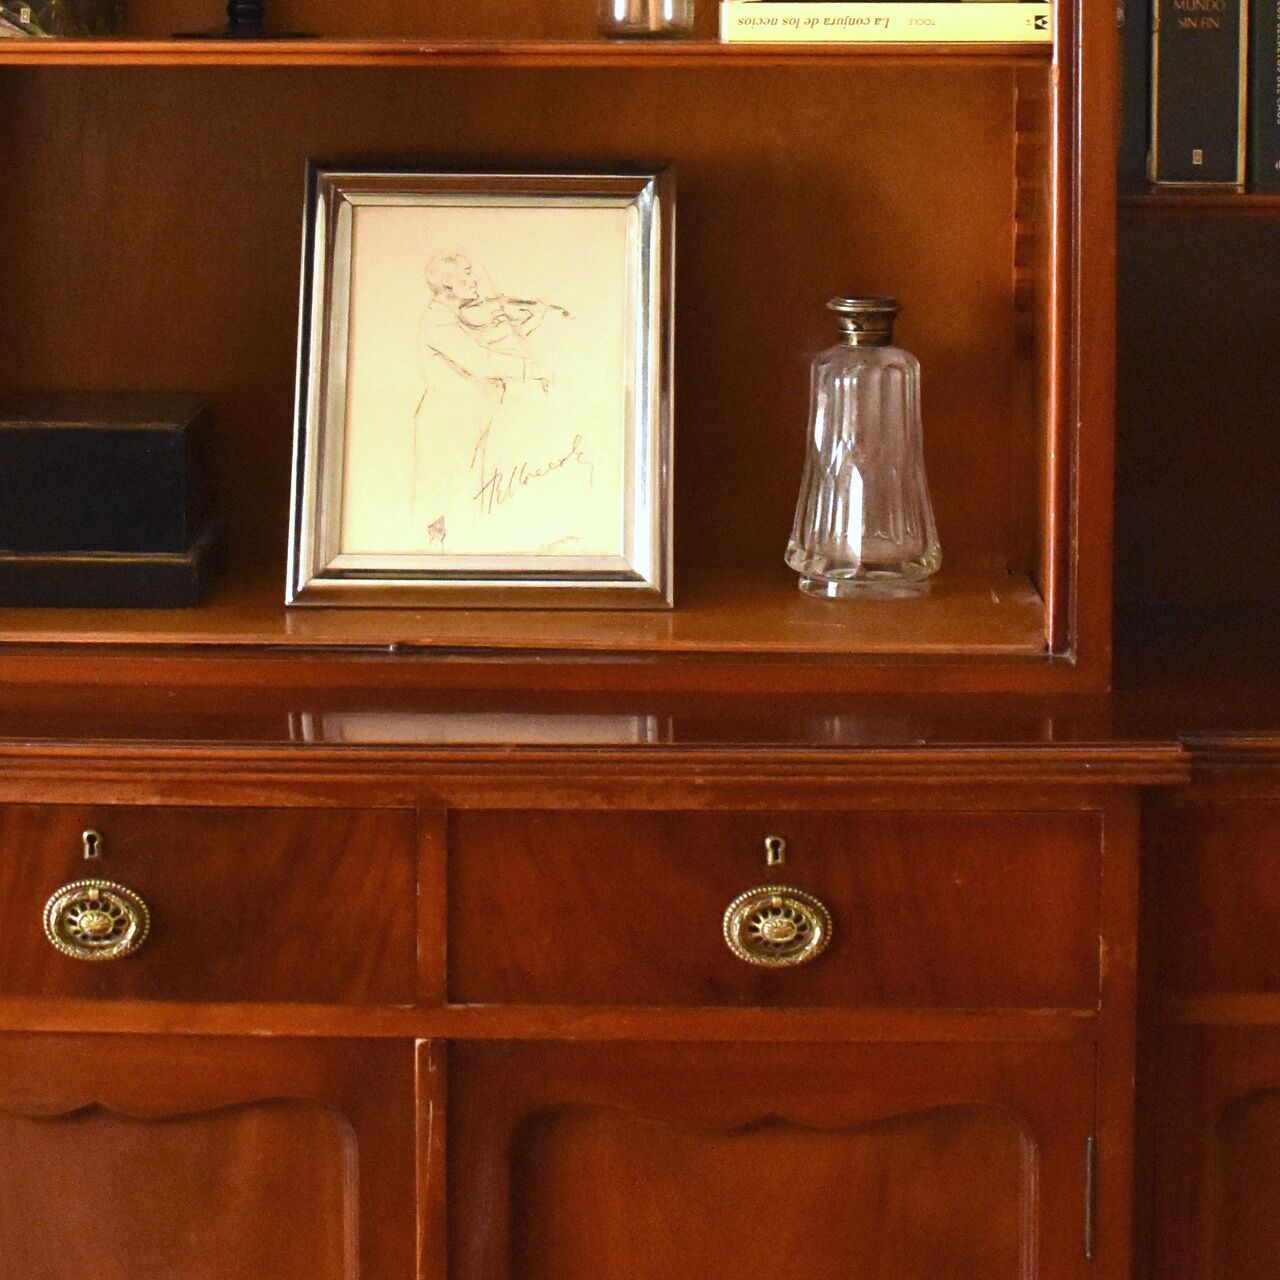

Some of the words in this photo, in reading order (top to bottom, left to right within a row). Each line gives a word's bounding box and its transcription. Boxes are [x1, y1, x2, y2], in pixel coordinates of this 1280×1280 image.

[737, 16, 777, 27] necios
[782, 17, 800, 29] los
[803, 17, 819, 29] de
[823, 15, 871, 28] conjura
[874, 17, 890, 28] La
